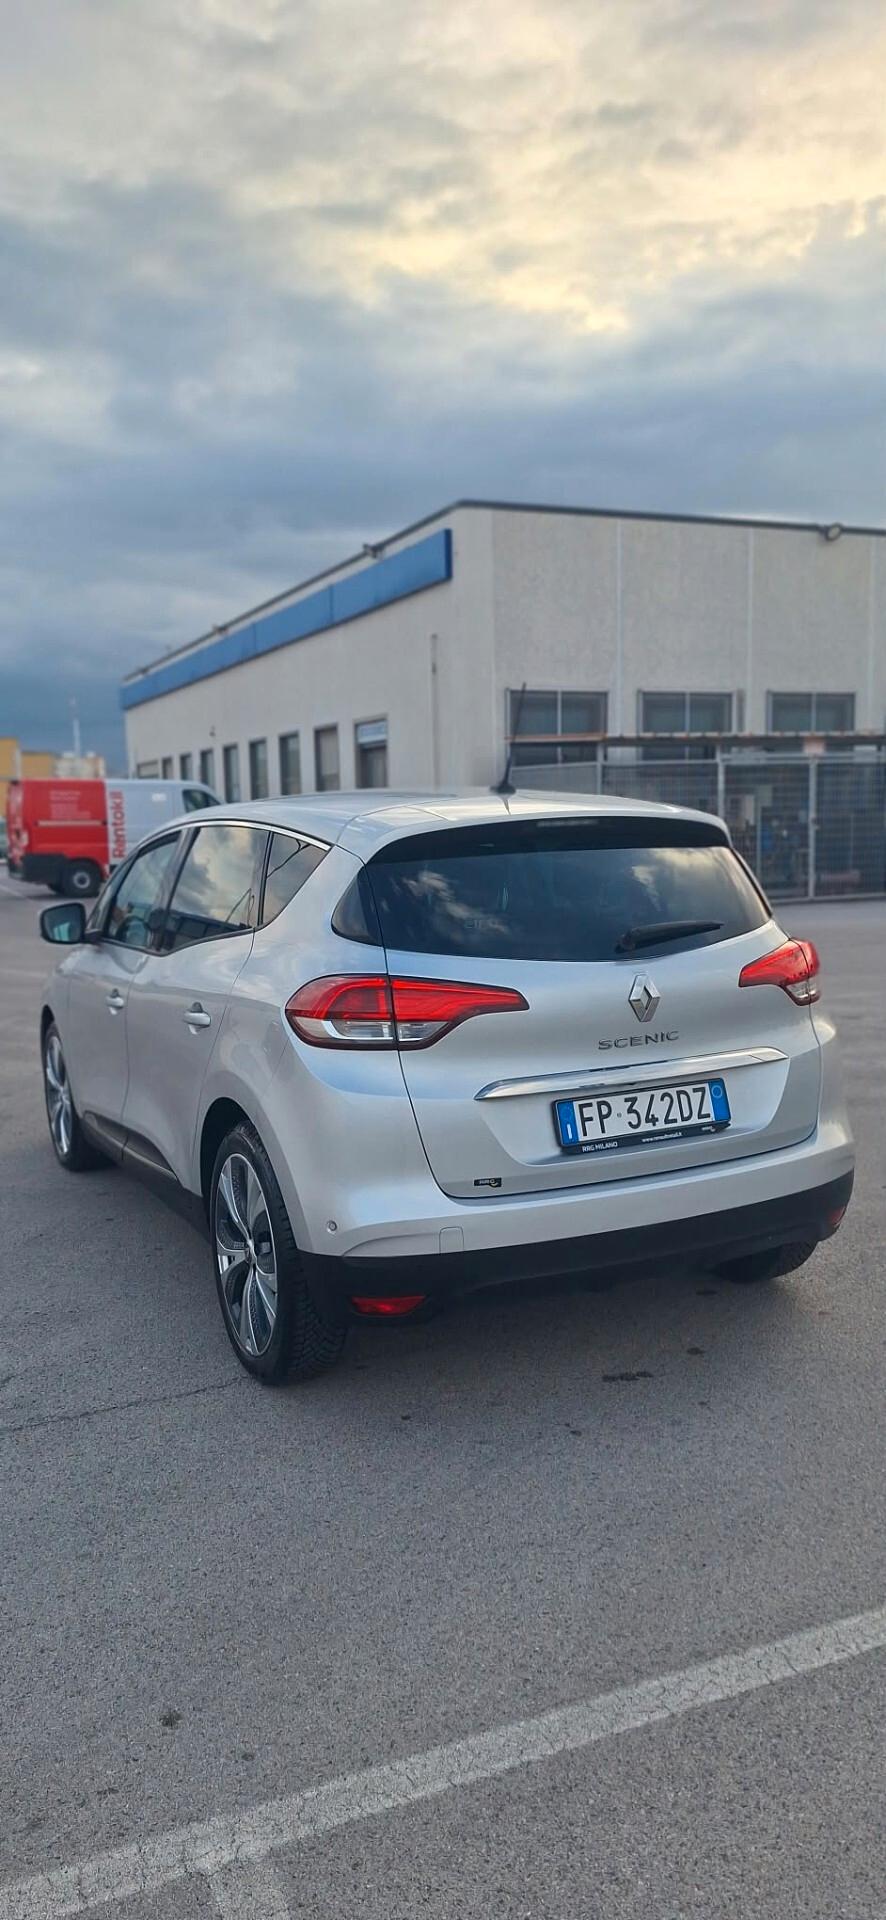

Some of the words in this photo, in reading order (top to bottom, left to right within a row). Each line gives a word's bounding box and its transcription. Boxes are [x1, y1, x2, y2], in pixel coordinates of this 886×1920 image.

[110, 791, 125, 859] Rentokil
[598, 1031, 679, 1050] SCENIC
[578, 1100, 612, 1137] FP
[624, 1086, 711, 1130] 342DZ
[595, 1141, 618, 1150] MILANO
